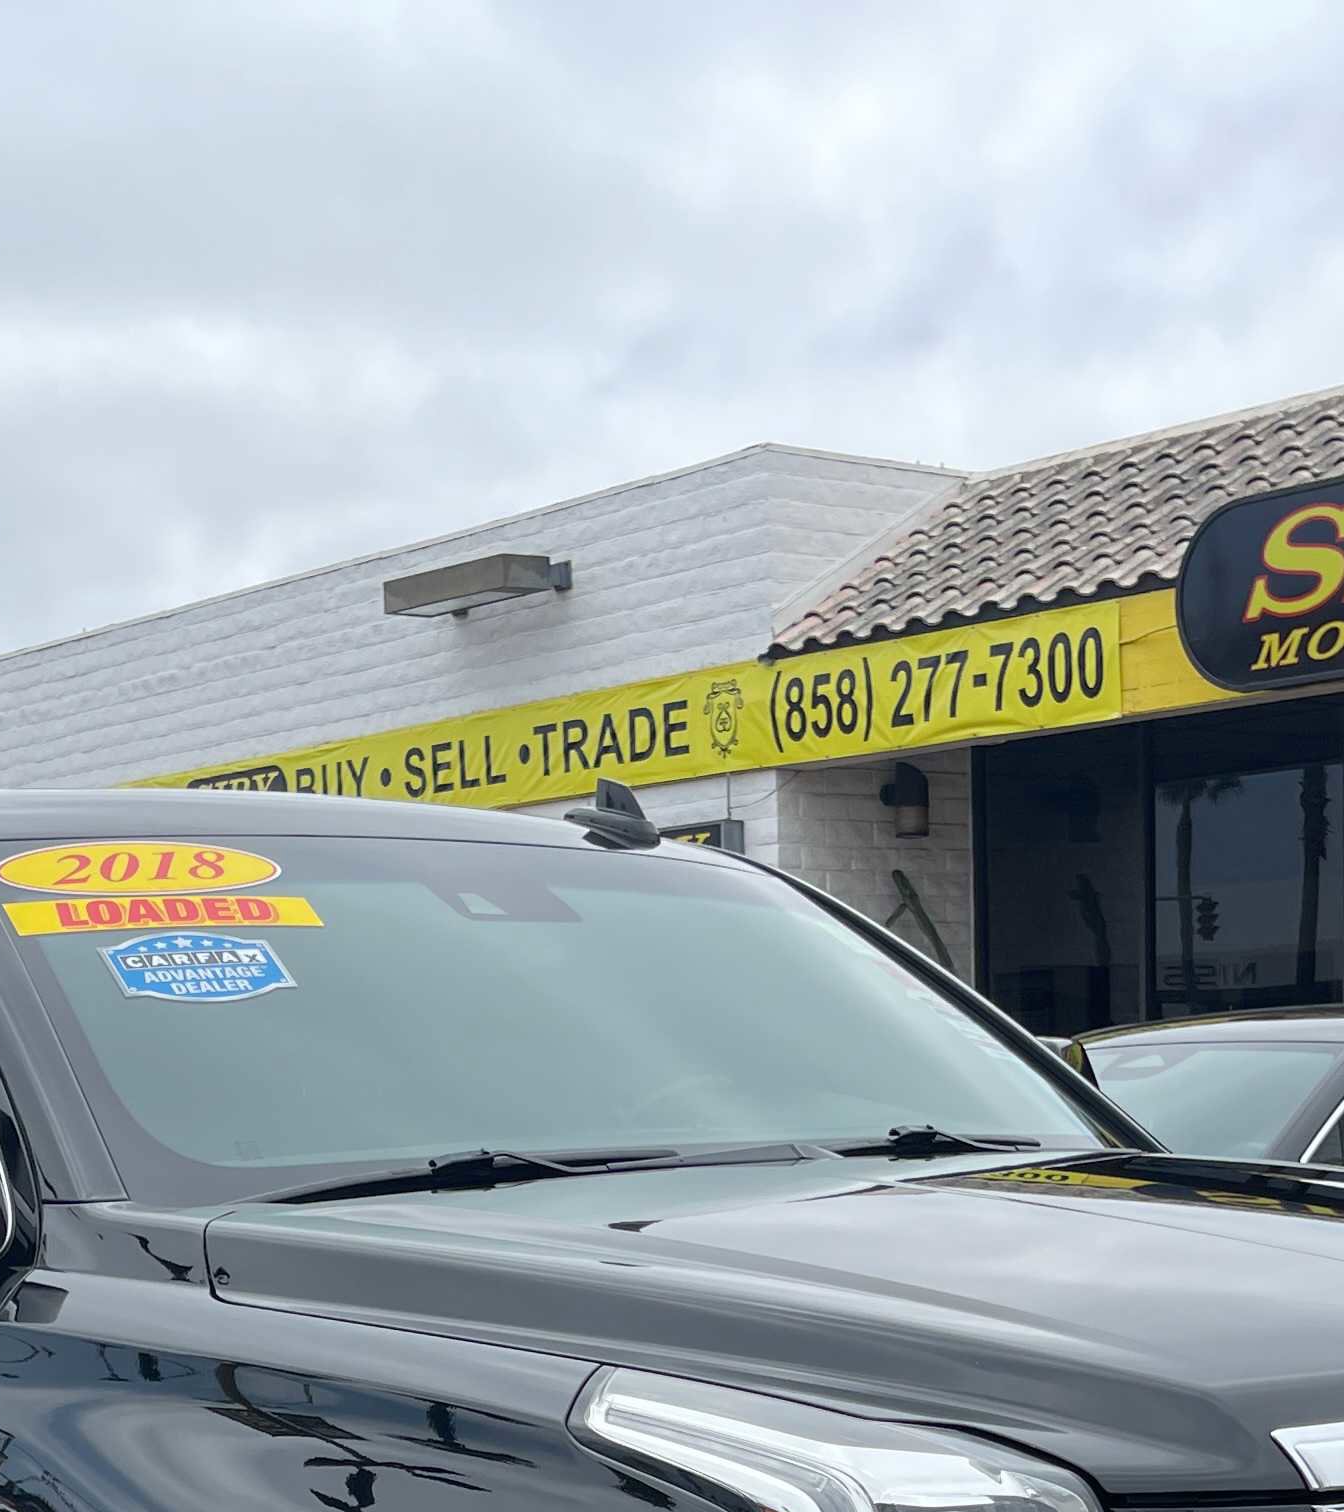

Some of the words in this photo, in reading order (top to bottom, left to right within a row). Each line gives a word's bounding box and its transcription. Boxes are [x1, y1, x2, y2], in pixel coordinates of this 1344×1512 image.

[769, 657, 874, 753] (858)
[890, 626, 1104, 729] 277-7300
[296, 756, 369, 797] BUY
[404, 735, 506, 798] SELL
[533, 700, 690, 776] TRADE
[52, 850, 226, 886] 2018
[56, 898, 280, 929] LOADED
[122, 950, 267, 970] CARFAX
[143, 965, 266, 985] ADVANTAGE
[170, 978, 254, 996] DEALER
